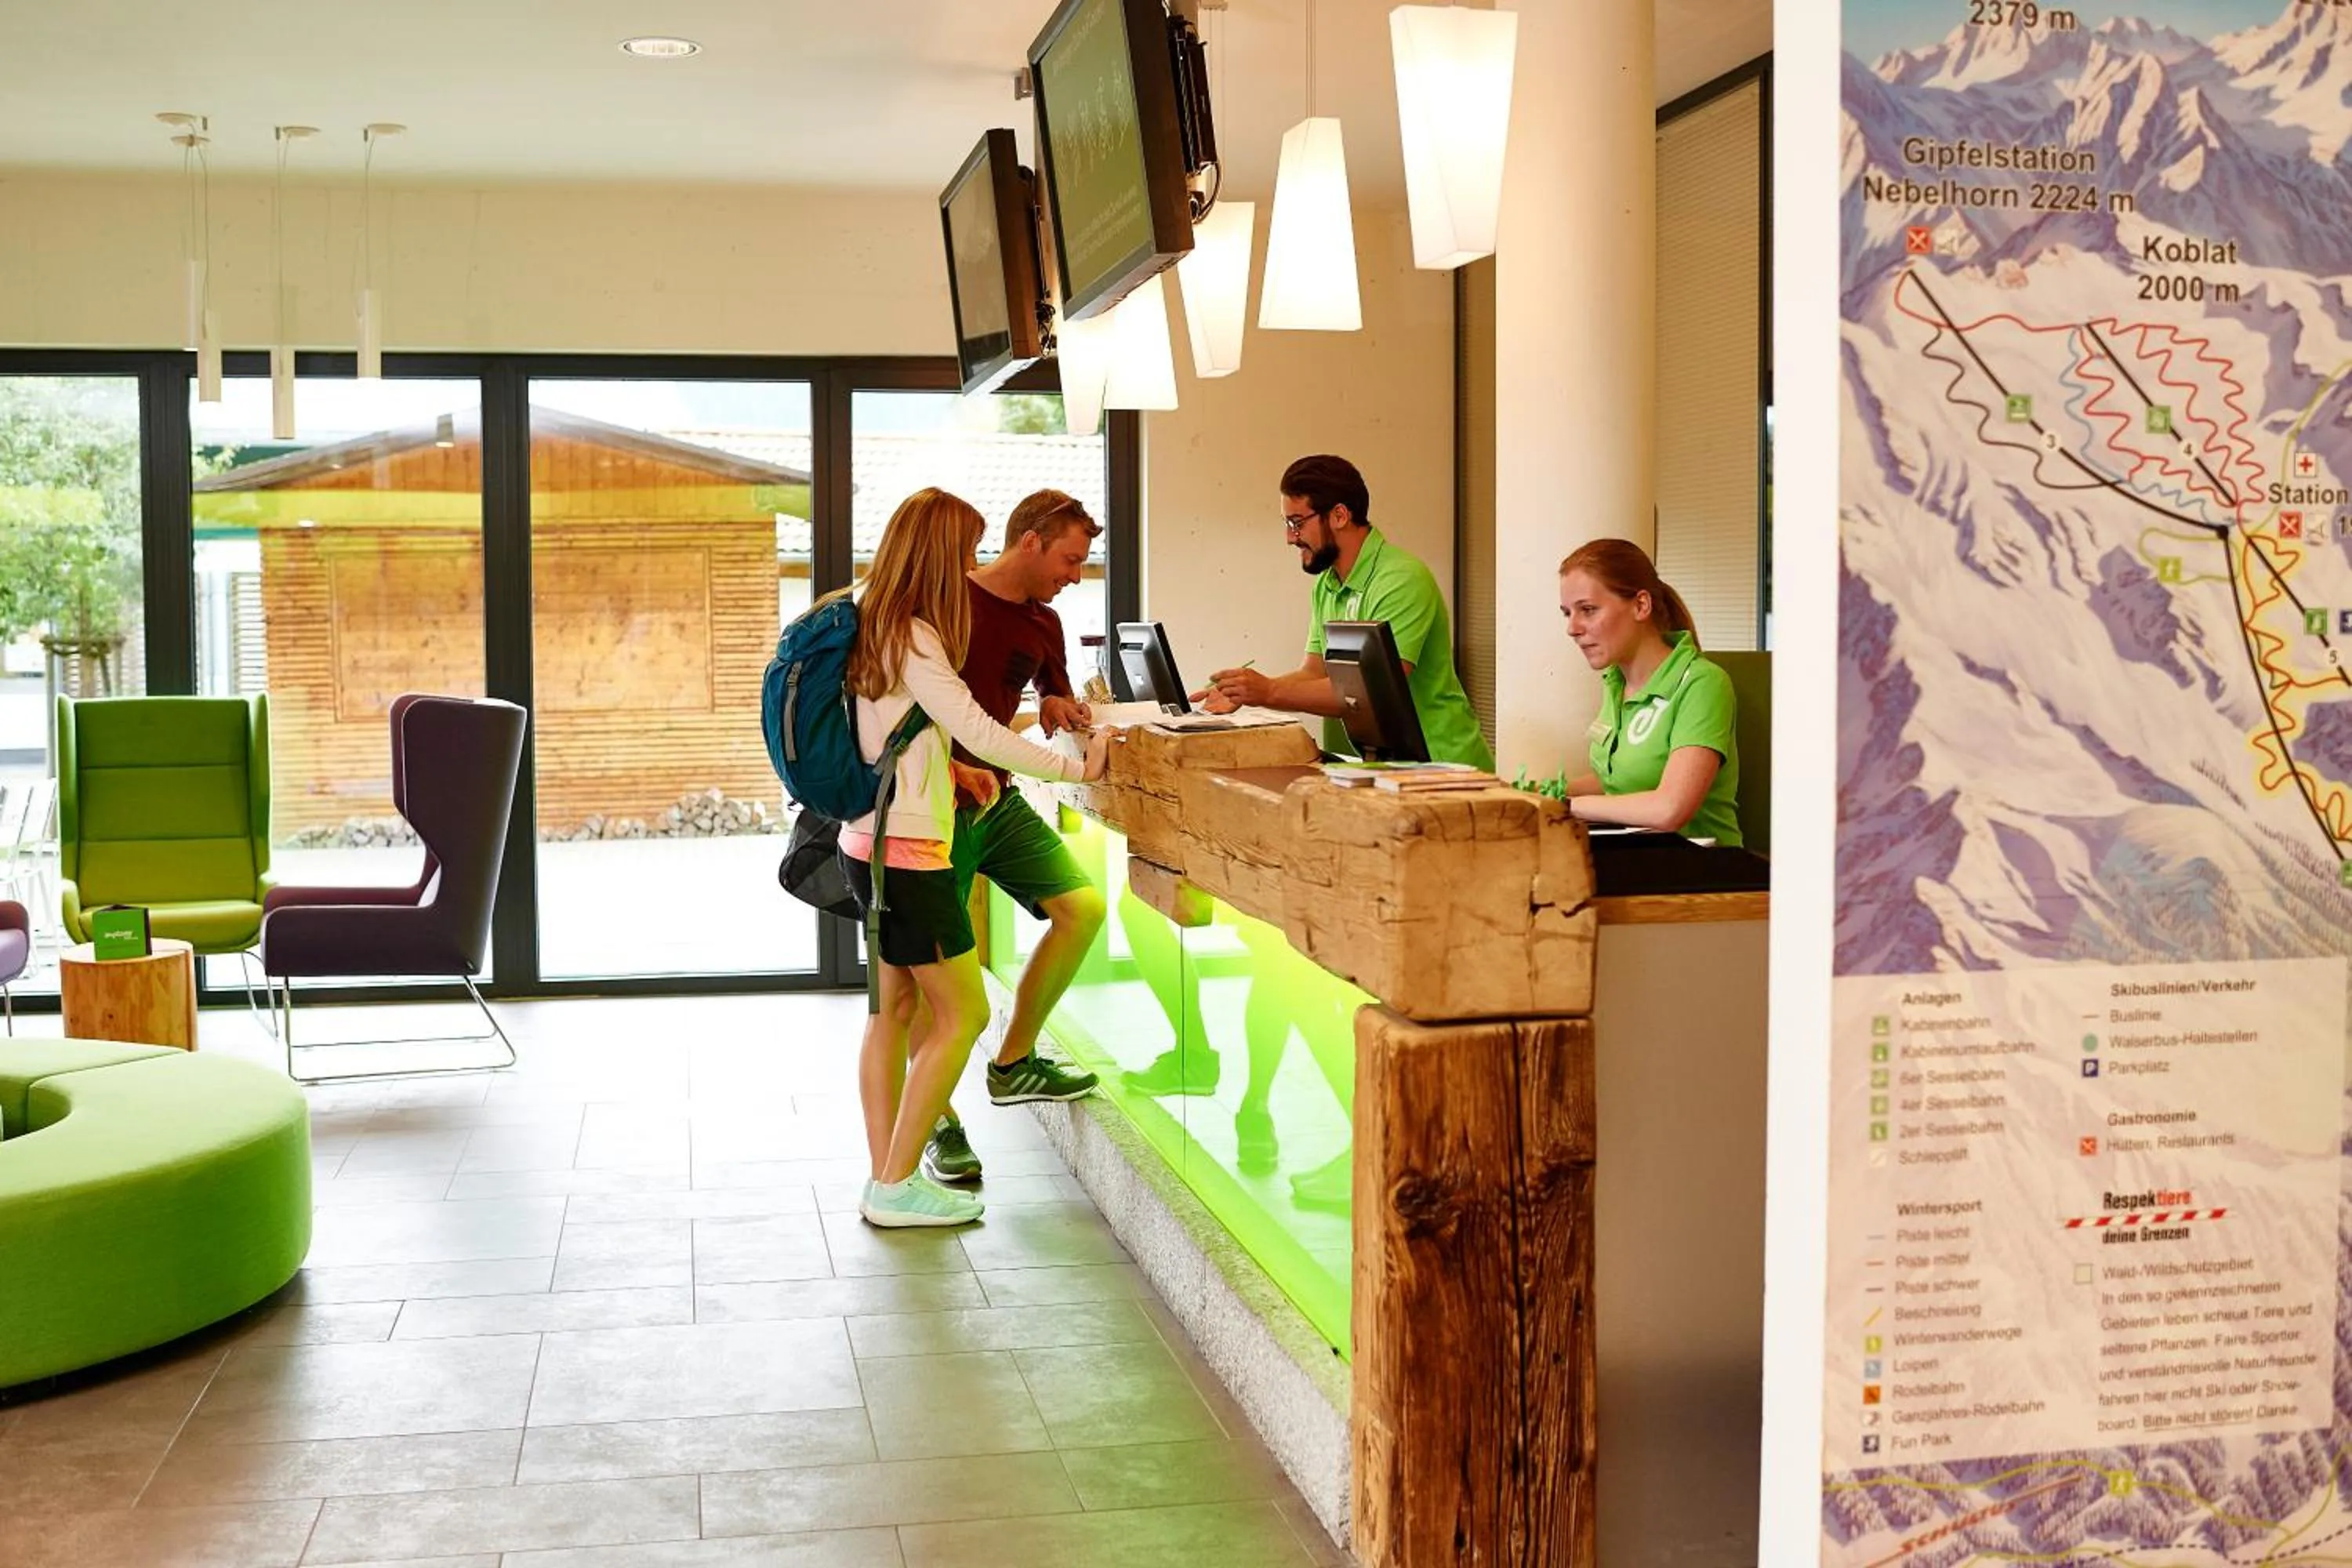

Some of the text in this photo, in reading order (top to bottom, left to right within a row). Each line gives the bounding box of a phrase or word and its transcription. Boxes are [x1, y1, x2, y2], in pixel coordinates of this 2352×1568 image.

[1969, 0, 2074, 30] 2379 m
[1903, 136, 2096, 174] Gipfelstation
[1863, 176, 2133, 212] Nebelhorn 2224 m
[2143, 235, 2237, 264] Koblat
[2137, 275, 2240, 303] 2000 m
[2045, 434, 2056, 449] 3
[2183, 441, 2193, 456] 4
[2268, 482, 2348, 505] Station
[2339, 516, 2352, 535] 1
[2328, 649, 2338, 664] 5
[2111, 979, 2256, 997] Skibuslinien/Verkehr
[1901, 992, 1962, 1007] Anlagen
[2110, 1009, 2161, 1023] Buslinie
[2108, 1060, 2170, 1076] Parkplatz
[2107, 1110, 2197, 1127] Gastronomie
[2157, 1132, 2235, 1149] Restaurants
[1896, 1200, 1983, 1216] Wintersport
[2103, 1189, 2192, 1211] Respektiere
[1896, 1226, 1970, 1242] Piste leicht
[2102, 1225, 2190, 1244] deine Grenzen
[1895, 1257, 1930, 1268] Piste
[1895, 1279, 1980, 1294] Piste schwer
[2118, 1290, 2143, 1305] den
[2101, 1315, 2160, 1330] Gebieten
[2163, 1312, 2199, 1326] leben
[2288, 1303, 2313, 1316] und
[1893, 1327, 2023, 1346] Winterwanderwege
[2100, 1341, 2147, 1356] seltene
[1893, 1359, 1939, 1374] Loipen
[2099, 1368, 2125, 1381] und
[1892, 1381, 1965, 1398] Rodelbahn
[2099, 1392, 2140, 1406] fahren
[2171, 1386, 2202, 1400] nicht
[2205, 1384, 2226, 1398] Ski
[2228, 1381, 2257, 1396] oder
[2143, 1414, 2172, 1428] Bitte
[2176, 1410, 2205, 1425] nicht
[1891, 1433, 1952, 1450] Fun Park
